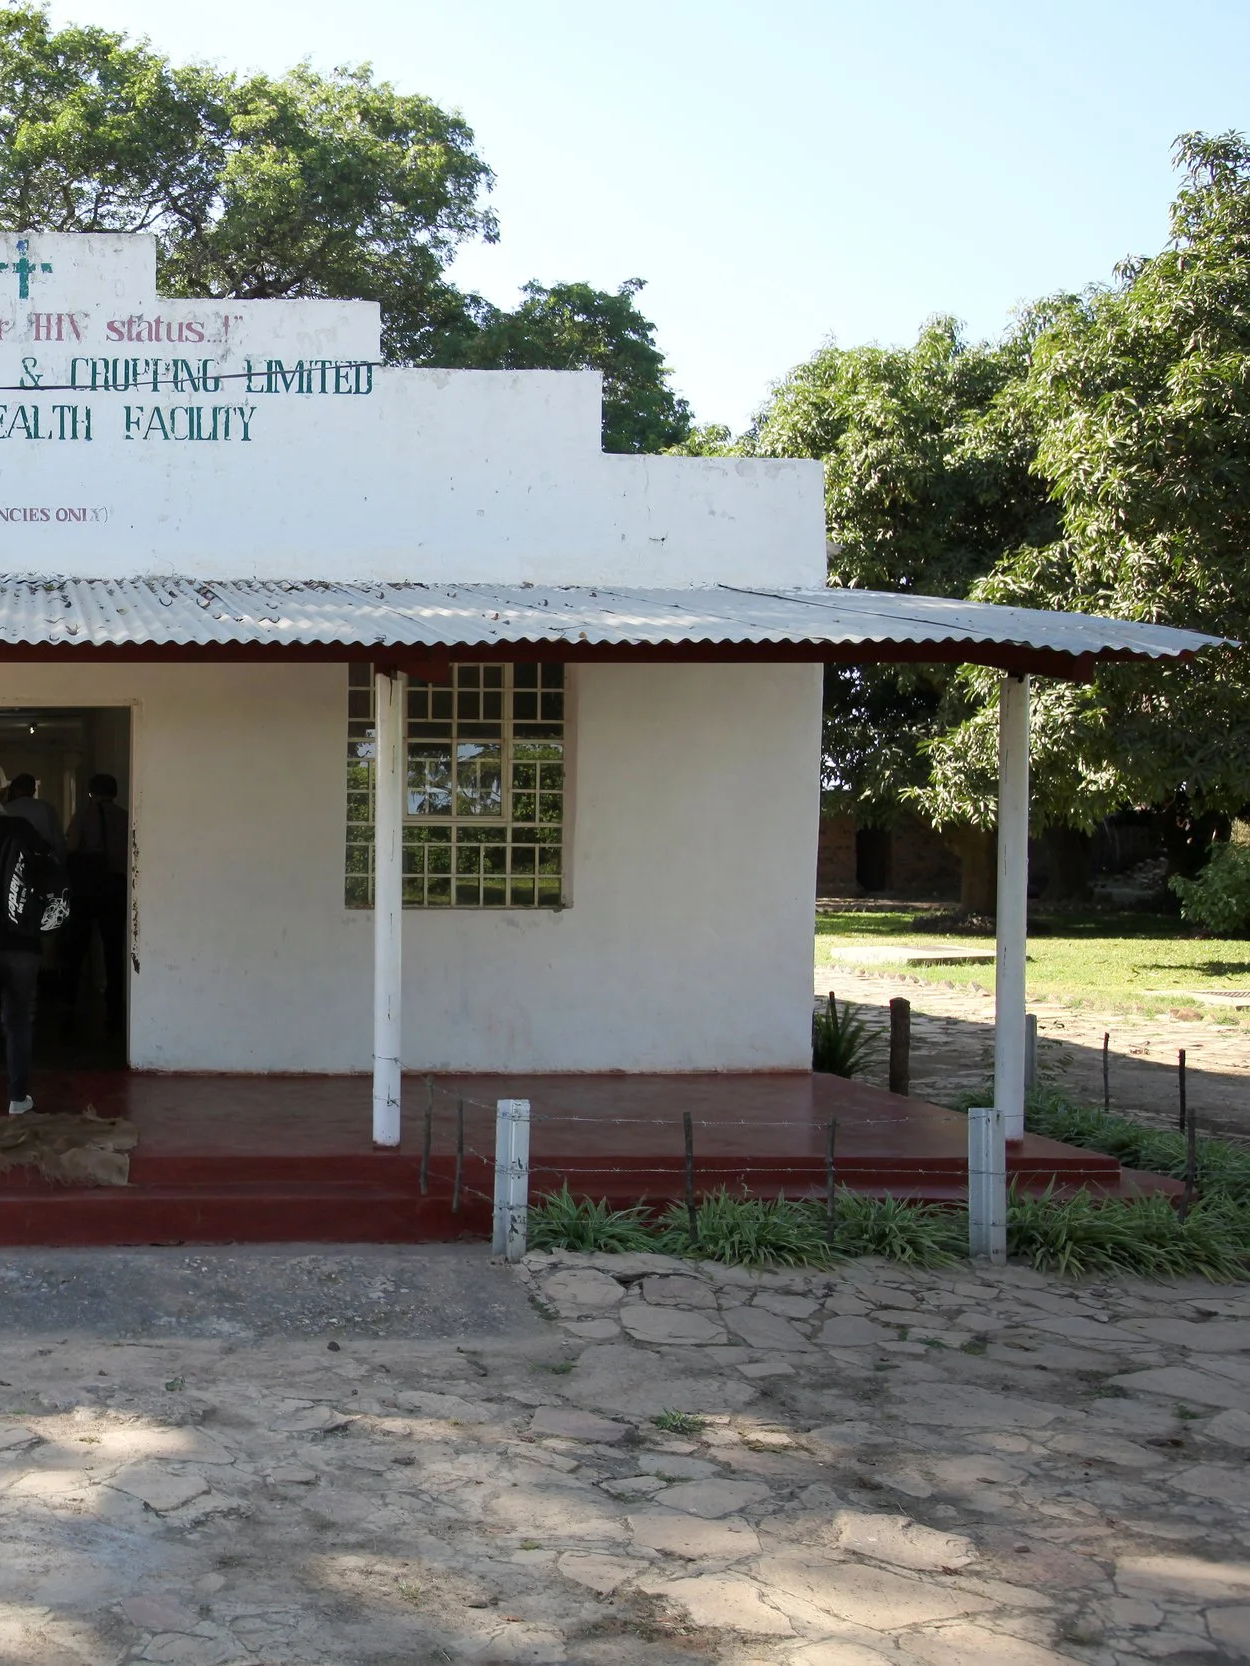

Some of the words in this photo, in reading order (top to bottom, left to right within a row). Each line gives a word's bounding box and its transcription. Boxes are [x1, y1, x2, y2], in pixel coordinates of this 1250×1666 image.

[33, 312, 88, 342] HIV
[20, 356, 44, 387] &
[244, 359, 373, 395] LIMITED
[124, 405, 258, 441] FACILITY
